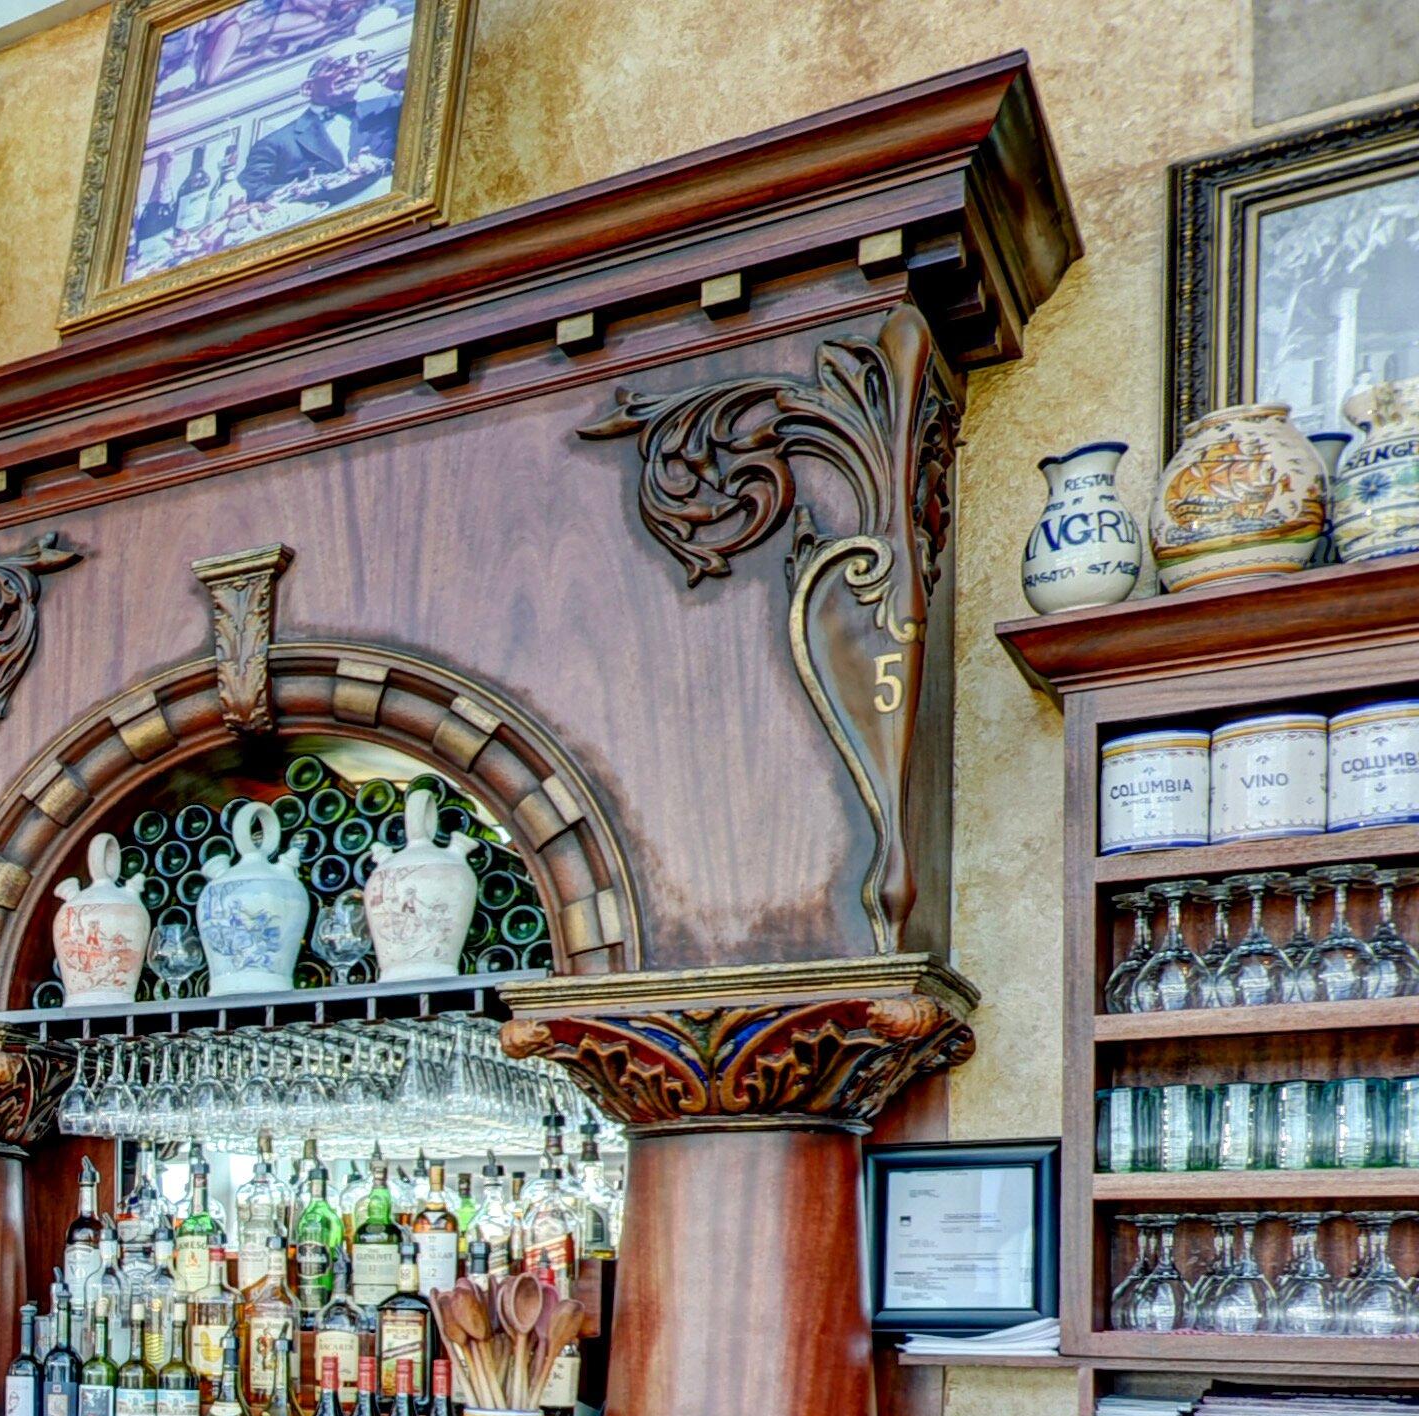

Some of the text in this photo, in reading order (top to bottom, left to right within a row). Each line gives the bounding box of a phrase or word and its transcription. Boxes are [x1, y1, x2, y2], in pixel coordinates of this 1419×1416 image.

[874, 653, 902, 713] 5
[1341, 752, 1418, 775] COLUMB
[1110, 779, 1193, 800] COLUMBIA
[1241, 773, 1289, 789] VINO
